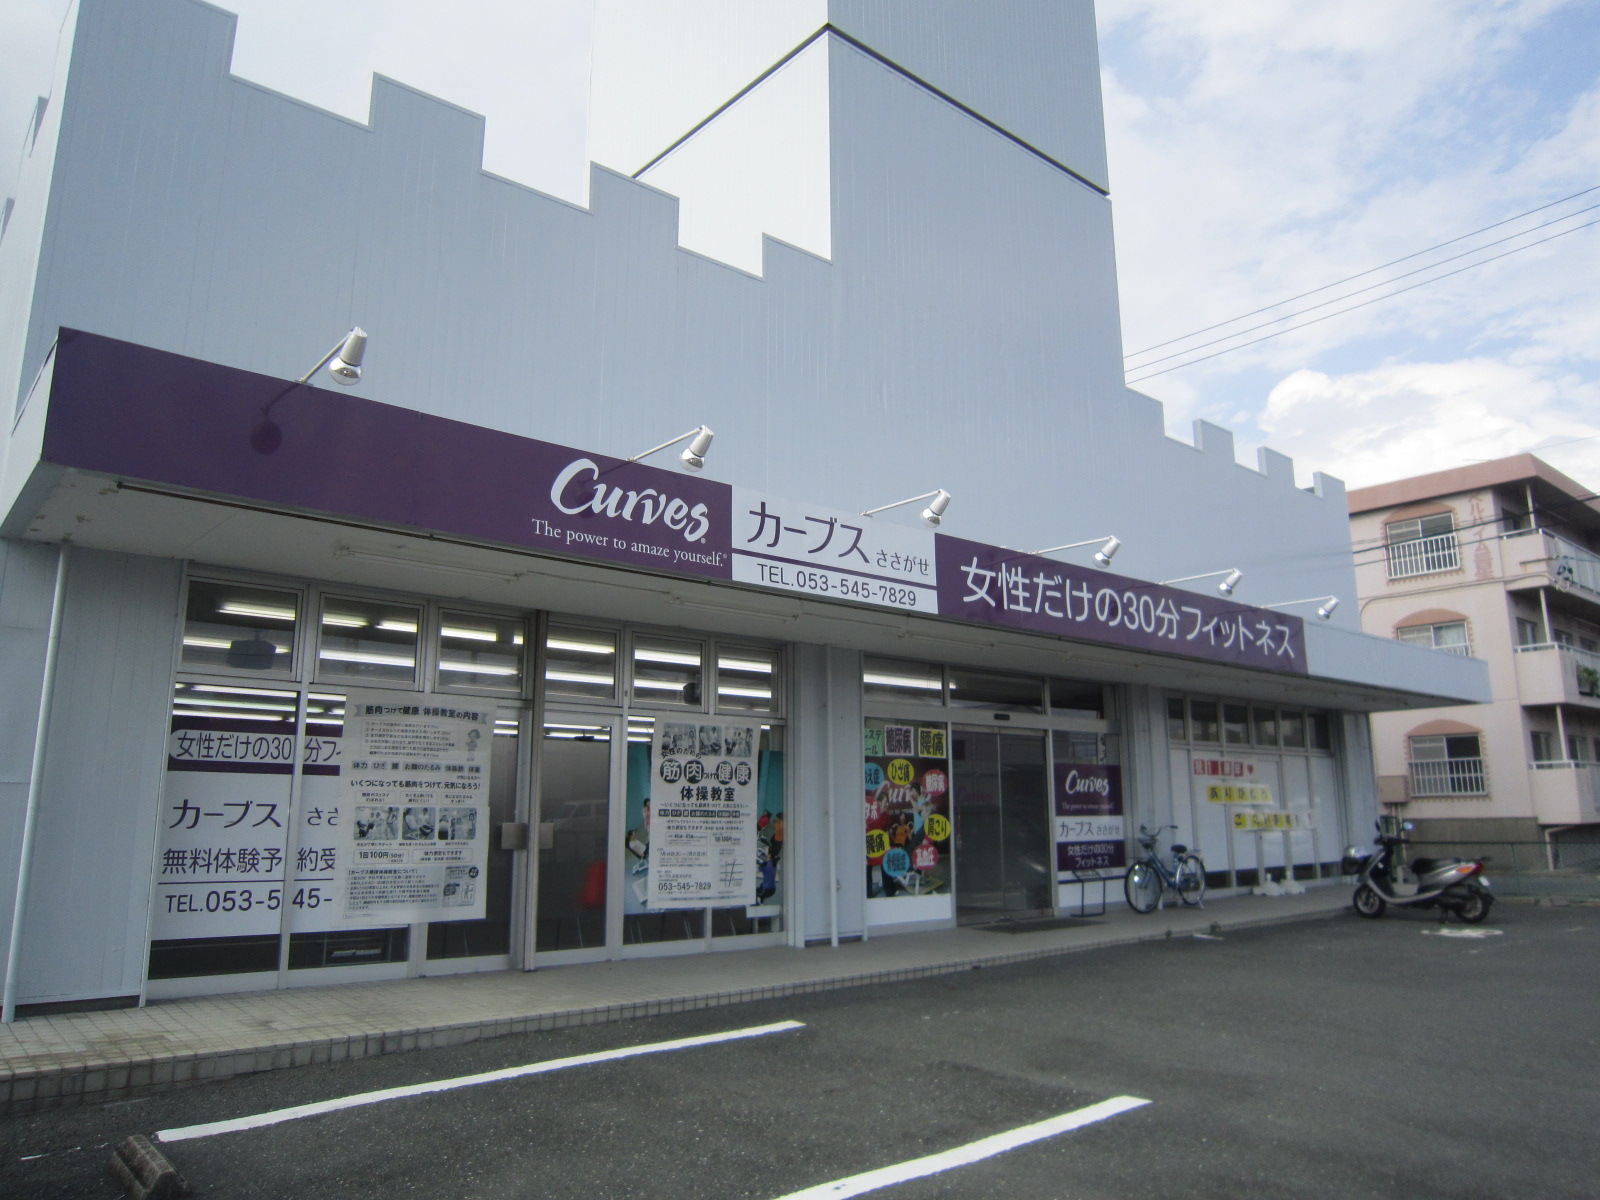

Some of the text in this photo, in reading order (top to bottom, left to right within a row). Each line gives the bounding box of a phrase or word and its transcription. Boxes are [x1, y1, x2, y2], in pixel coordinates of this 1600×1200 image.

[551, 458, 709, 542] Curves
[531, 518, 724, 567] The power to amaze yourself.
[747, 501, 930, 576] カーブス ささがせ
[757, 563, 917, 606] TEL.053-545-7829
[960, 557, 1295, 658] 女性だけの30分フィットネス
[920, 730, 944, 756] 腰痛
[891, 763, 910, 782] ひざ痛
[1065, 769, 1109, 796] Curves
[681, 786, 735, 802] 体操教室
[168, 799, 282, 829] カーブス
[927, 817, 947, 836] 肩こり
[1060, 821, 1094, 838] カーブス
[658, 882, 712, 891] 053-545-7829
